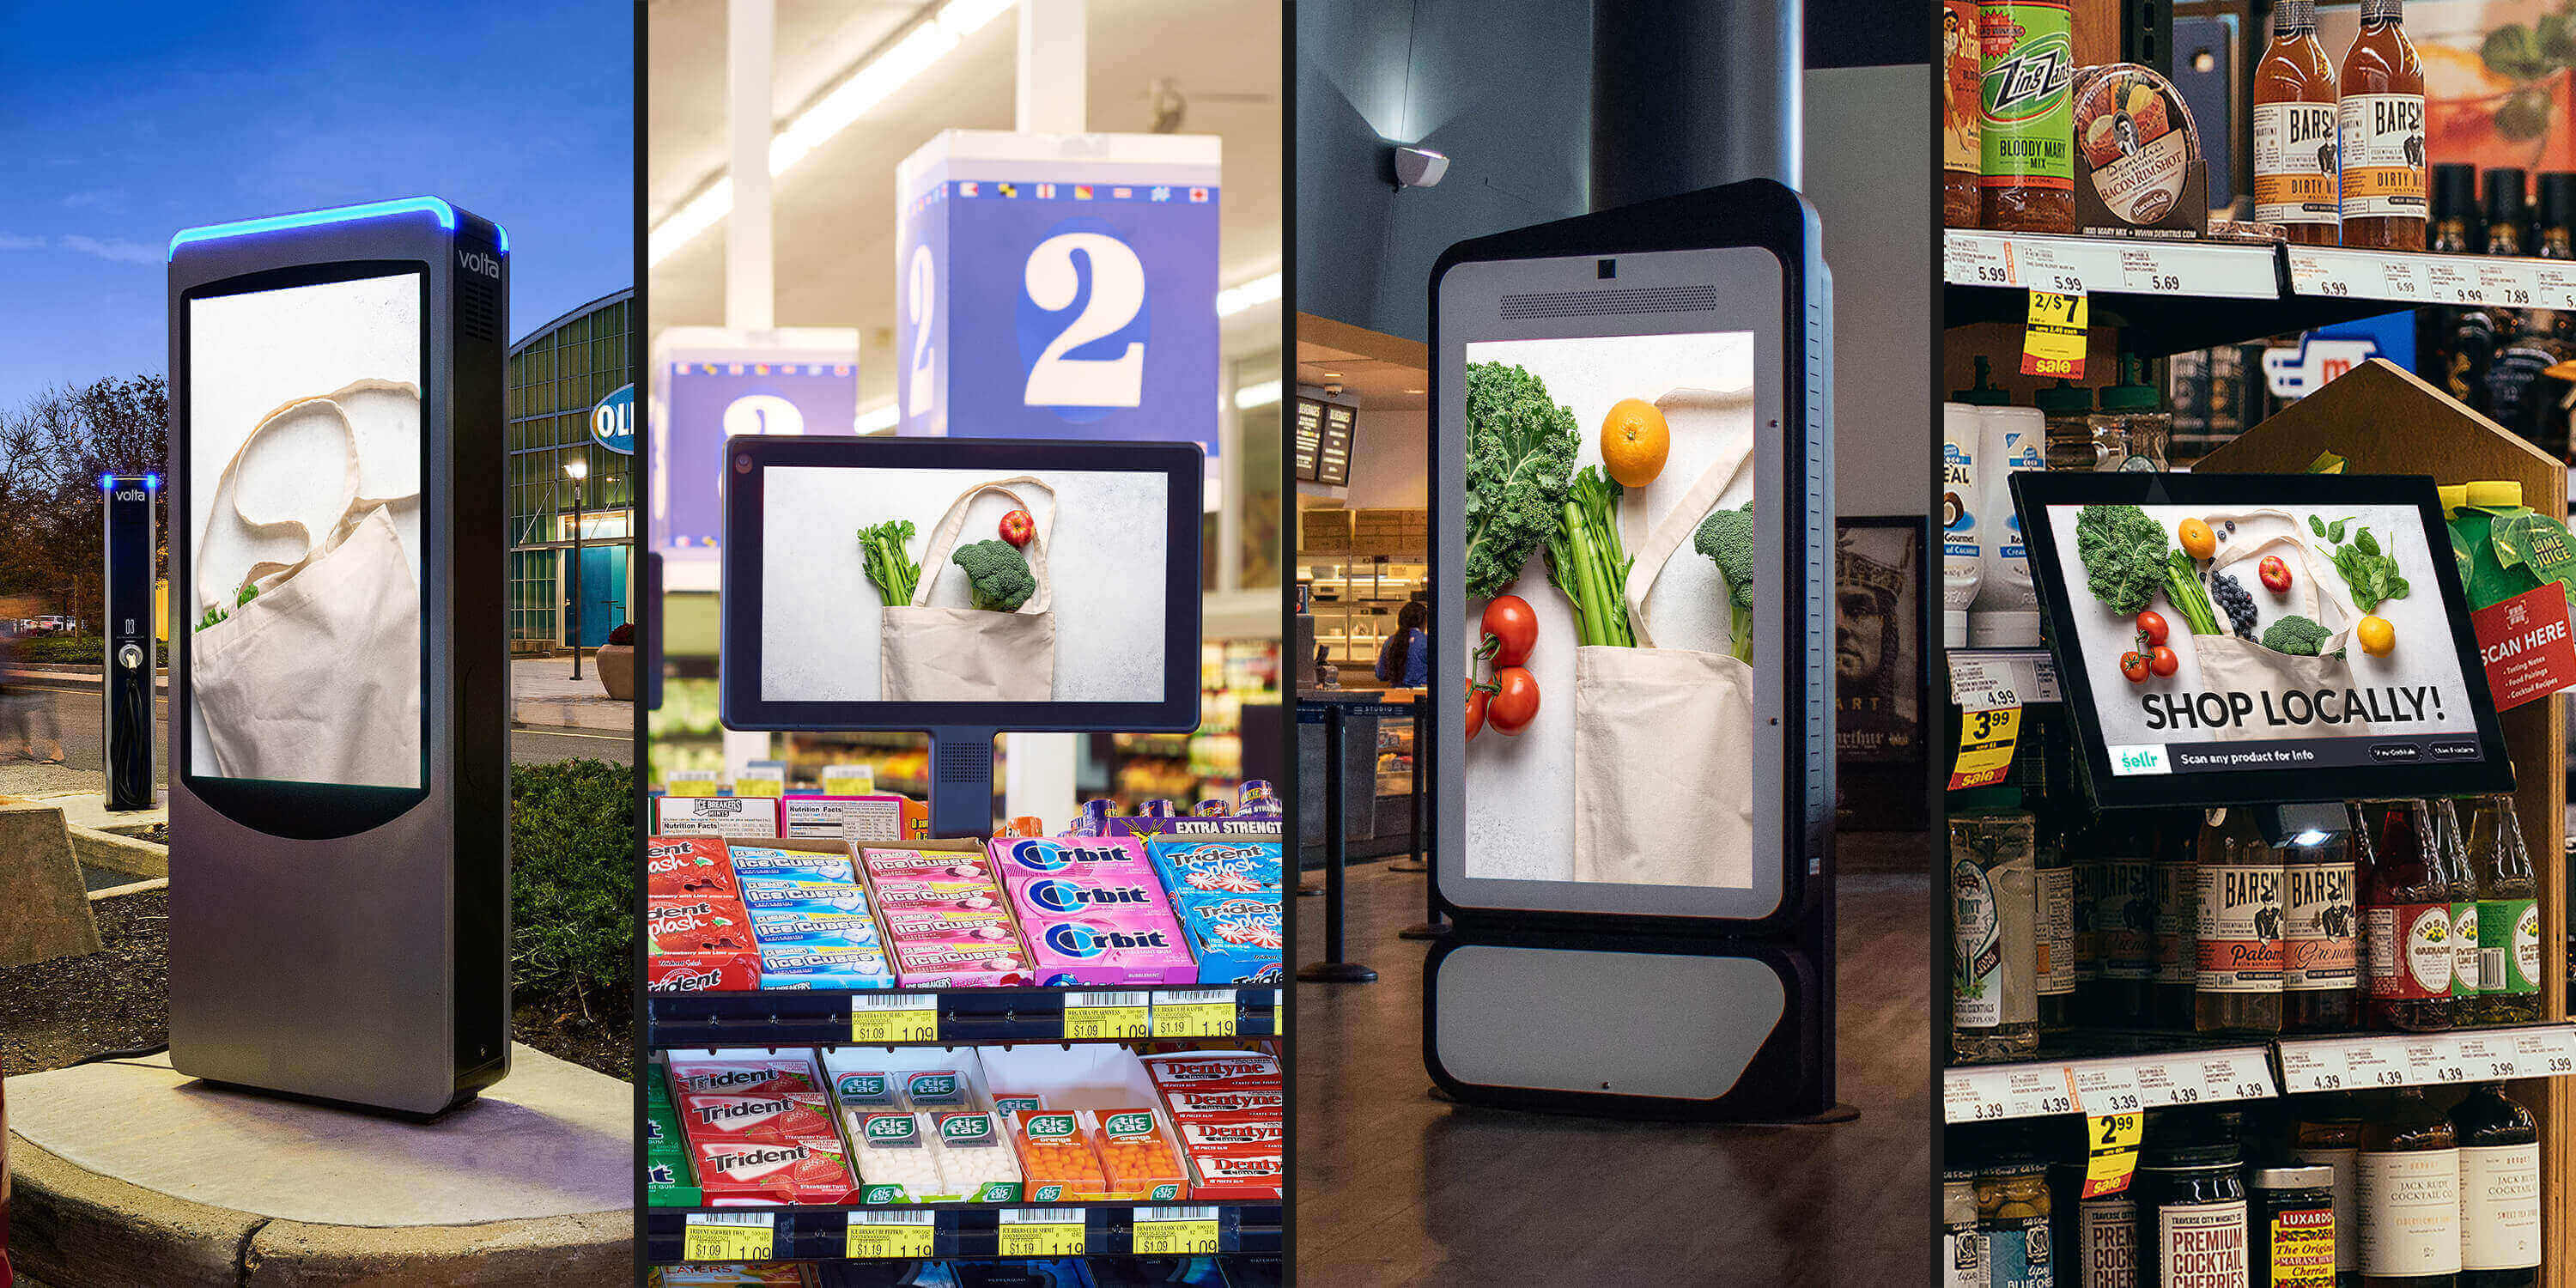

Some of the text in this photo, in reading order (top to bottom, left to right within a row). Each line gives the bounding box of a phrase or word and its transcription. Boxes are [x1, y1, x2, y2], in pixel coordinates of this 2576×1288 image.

[2000, 140, 2067, 159] BLOODY MARY
[2030, 157, 2047, 169] MIX
[2101, 172, 2138, 200] BACON
[2291, 179, 2323, 194] DIRTY
[2377, 172, 2409, 187] DIRTY
[459, 249, 500, 279] volta
[1978, 265, 2006, 283] 5.99
[2054, 276, 2082, 292] 5.99
[2153, 275, 2179, 290] 5.69
[2321, 281, 2348, 295] 6.99
[2458, 289, 2482, 302] 9.99
[2505, 289, 2530, 304] 7.89
[1024, 232, 1145, 407] 2
[908, 244, 934, 418] 2
[2035, 359, 2072, 374] sale
[116, 489, 145, 501] volta
[1944, 533, 1975, 544] Gourmet
[2532, 534, 2564, 554] LIME
[2534, 546, 2573, 568] JUICE
[2481, 620, 2567, 667] SCAN HERE
[2508, 675, 2524, 687] Food
[1987, 689, 2016, 706] 4.99
[2510, 684, 2535, 698] Cocktail
[2142, 686, 2446, 731] SHOP LOCALLY!
[2121, 750, 2158, 771] sellr
[2181, 754, 2208, 766] Scan
[2209, 754, 2229, 765] any
[2231, 751, 2273, 765] product
[2274, 750, 2291, 762] for
[1962, 769, 1995, 787] sale
[695, 799, 742, 813] ICE BREAKERS
[1176, 821, 1283, 834] EXTRA STRENGT
[1011, 839, 1133, 872] Orbit
[1166, 845, 1264, 867] Trident
[1029, 878, 1151, 914] Orbit
[1044, 921, 1170, 959] Orbit
[1160, 1021, 1185, 1034] $1.19
[1167, 1063, 1265, 1077] Dentyne
[2490, 1061, 2515, 1077] 3.99
[2548, 1057, 2572, 1072] 3.99
[679, 1068, 779, 1092] Trident
[924, 1078, 950, 1086] tic
[2314, 1074, 2341, 1090] 4.39
[2377, 1071, 2403, 1086] 4.39
[2438, 1067, 2464, 1082] 4.39
[854, 1078, 879, 1087] tic
[2235, 1082, 2263, 1098] 4.39
[1183, 1094, 1282, 1107] Dentyne
[2109, 1094, 2139, 1110] 3.39
[2170, 1087, 2198, 1103] 4.39
[693, 1098, 797, 1125] Trident
[1974, 1103, 2003, 1120] 3.39
[2042, 1097, 2070, 1113] 4.39
[881, 1119, 909, 1128] tic
[956, 1118, 986, 1127] tic
[1041, 1117, 1068, 1127] tic
[1115, 1123, 1148, 1132] tac
[1119, 1115, 1147, 1125] tic
[874, 1126, 908, 1135] tac
[951, 1126, 984, 1135] tac
[1036, 1124, 1068, 1133] tac
[1197, 1125, 1282, 1139] Dentyn
[706, 1145, 811, 1174] Trident
[1213, 1159, 1282, 1174] Denty
[2093, 1176, 2121, 1194] sale
[2398, 1181, 2423, 1192] JACK
[2497, 1175, 2518, 1185] JACK
[2391, 1190, 2440, 1202] COCKTAIL
[2488, 1185, 2531, 1196] COCKTAIL
[2201, 1216, 2214, 1224] CITY
[2283, 1212, 2333, 1224] LUXARDO
[2172, 1228, 2243, 1253] PREMIUM
[2275, 1245, 2299, 1255] The
[2172, 1249, 2244, 1274] COCKTAIL
[665, 1266, 732, 1274] LAYERS
[2172, 1271, 2245, 1288] CHERRIES
